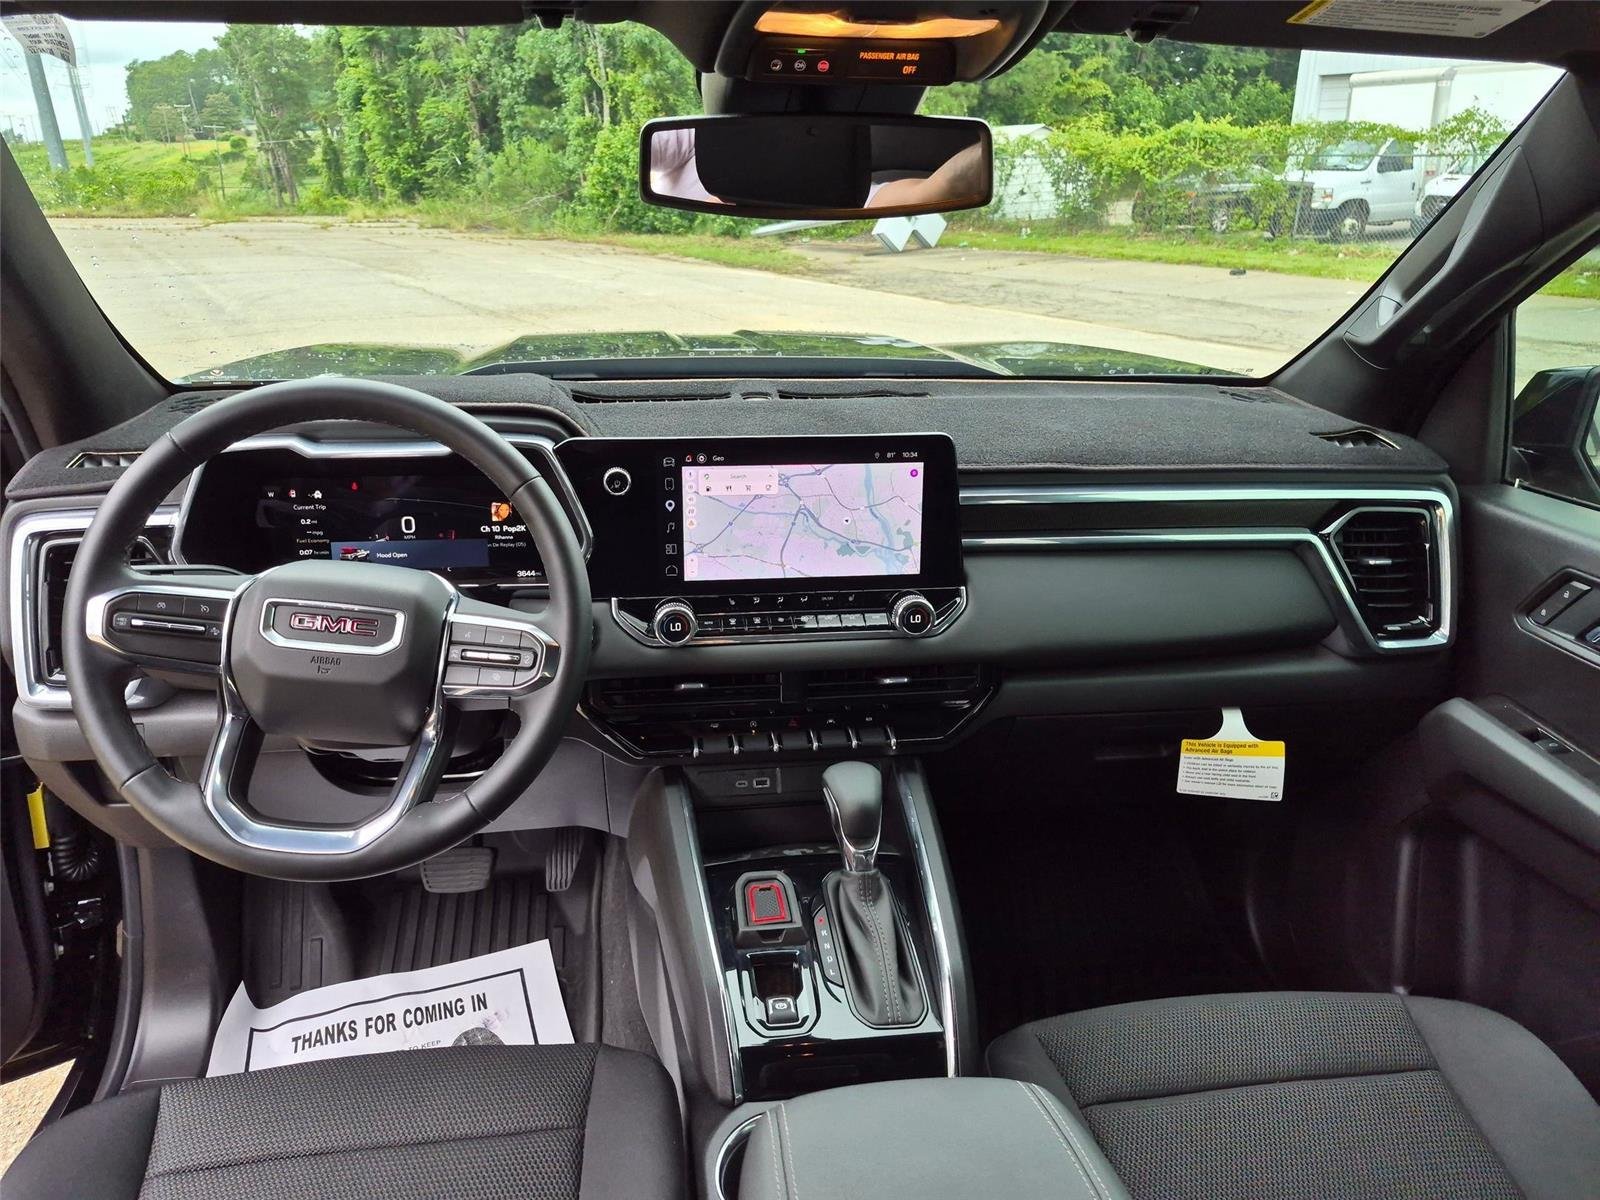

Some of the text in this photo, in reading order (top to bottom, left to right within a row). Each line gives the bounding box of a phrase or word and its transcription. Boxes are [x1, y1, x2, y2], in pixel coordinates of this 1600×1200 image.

[859, 51, 894, 60] PASSENGER
[902, 65, 916, 74] OFF
[401, 516, 416, 534] 0
[480, 524, 527, 534] Ch 10 Pop2K
[393, 552, 408, 560] Open
[910, 614, 922, 624] LO
[290, 612, 379, 637] GMC
[669, 622, 682, 632] LO
[310, 655, 342, 666] AIRBAG
[291, 993, 488, 1054] THANKS FOR COMING IN
[421, 1040, 442, 1049] KEEP
